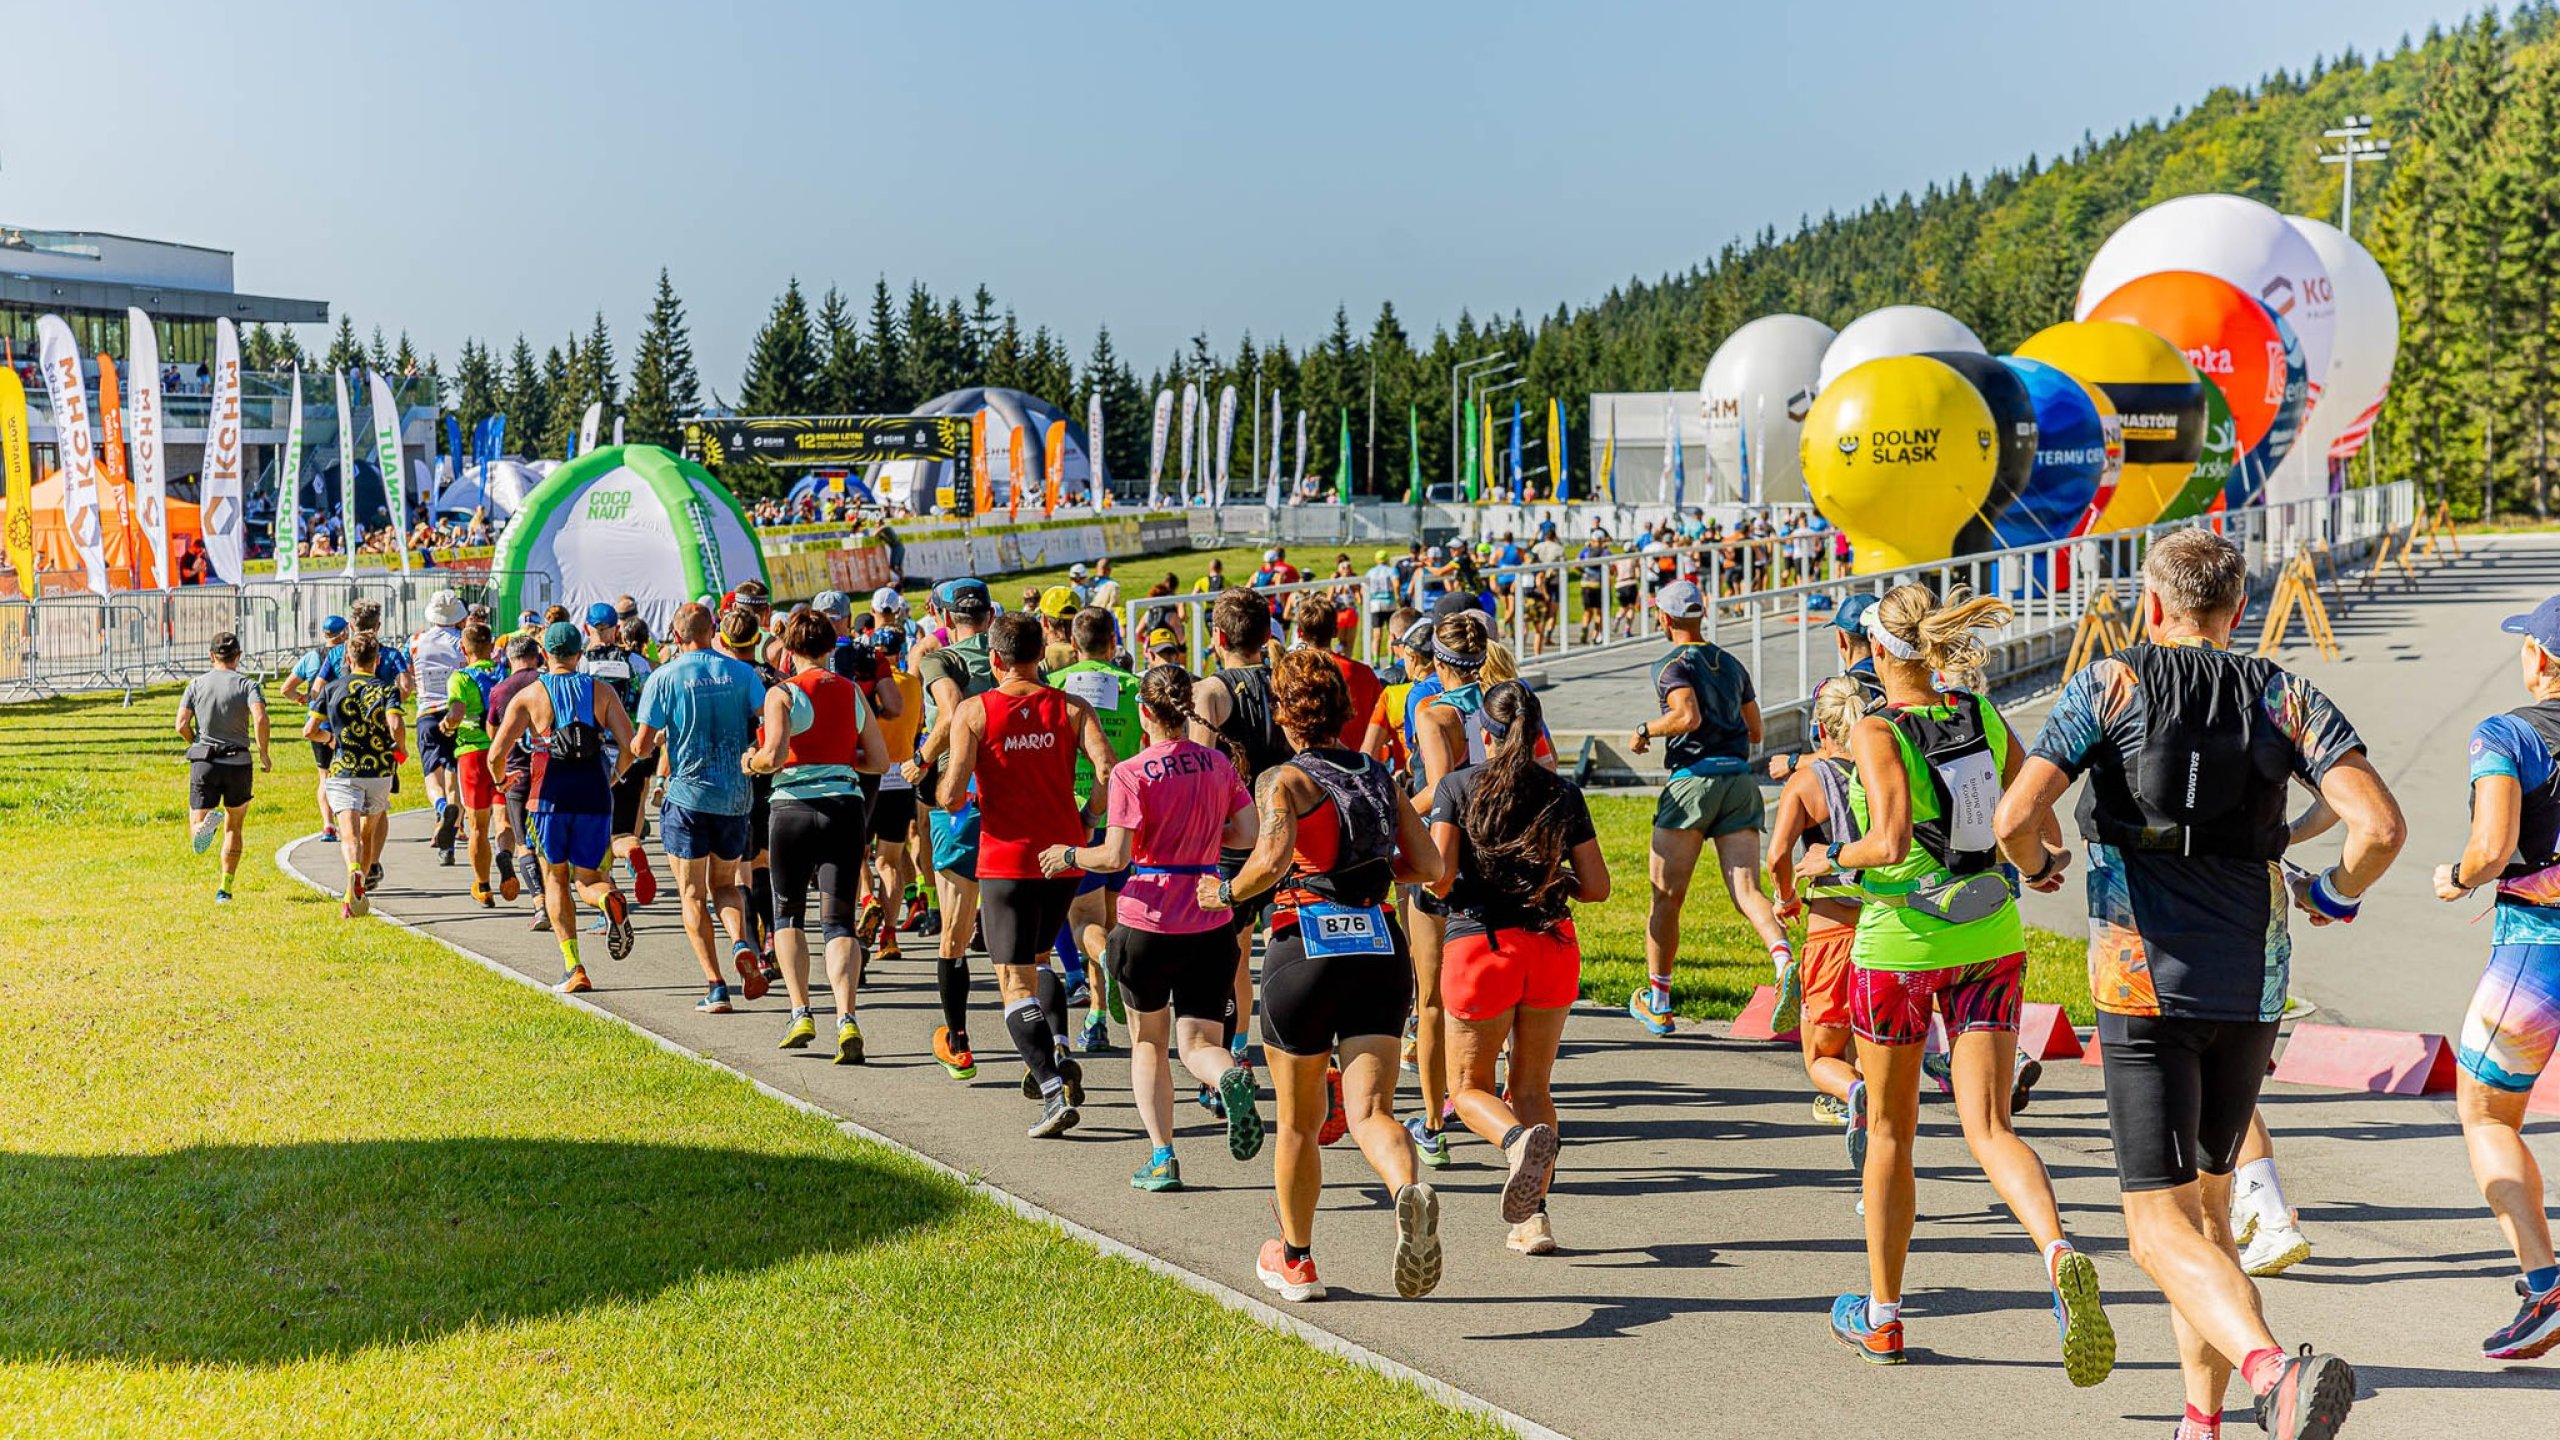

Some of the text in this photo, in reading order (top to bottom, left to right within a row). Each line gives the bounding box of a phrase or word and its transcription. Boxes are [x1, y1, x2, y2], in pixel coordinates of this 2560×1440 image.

[795, 433, 816, 449] 12
[1872, 429, 1941, 446] DOLNY
[2036, 450, 2084, 466] TERMY
[589, 491, 632, 506] COCO
[586, 505, 631, 520] NAUT
[1004, 732, 1055, 752] MARIO
[1144, 752, 1214, 779] CREW
[2185, 751, 2200, 809] SALOMON
[1325, 917, 1366, 933] 876
